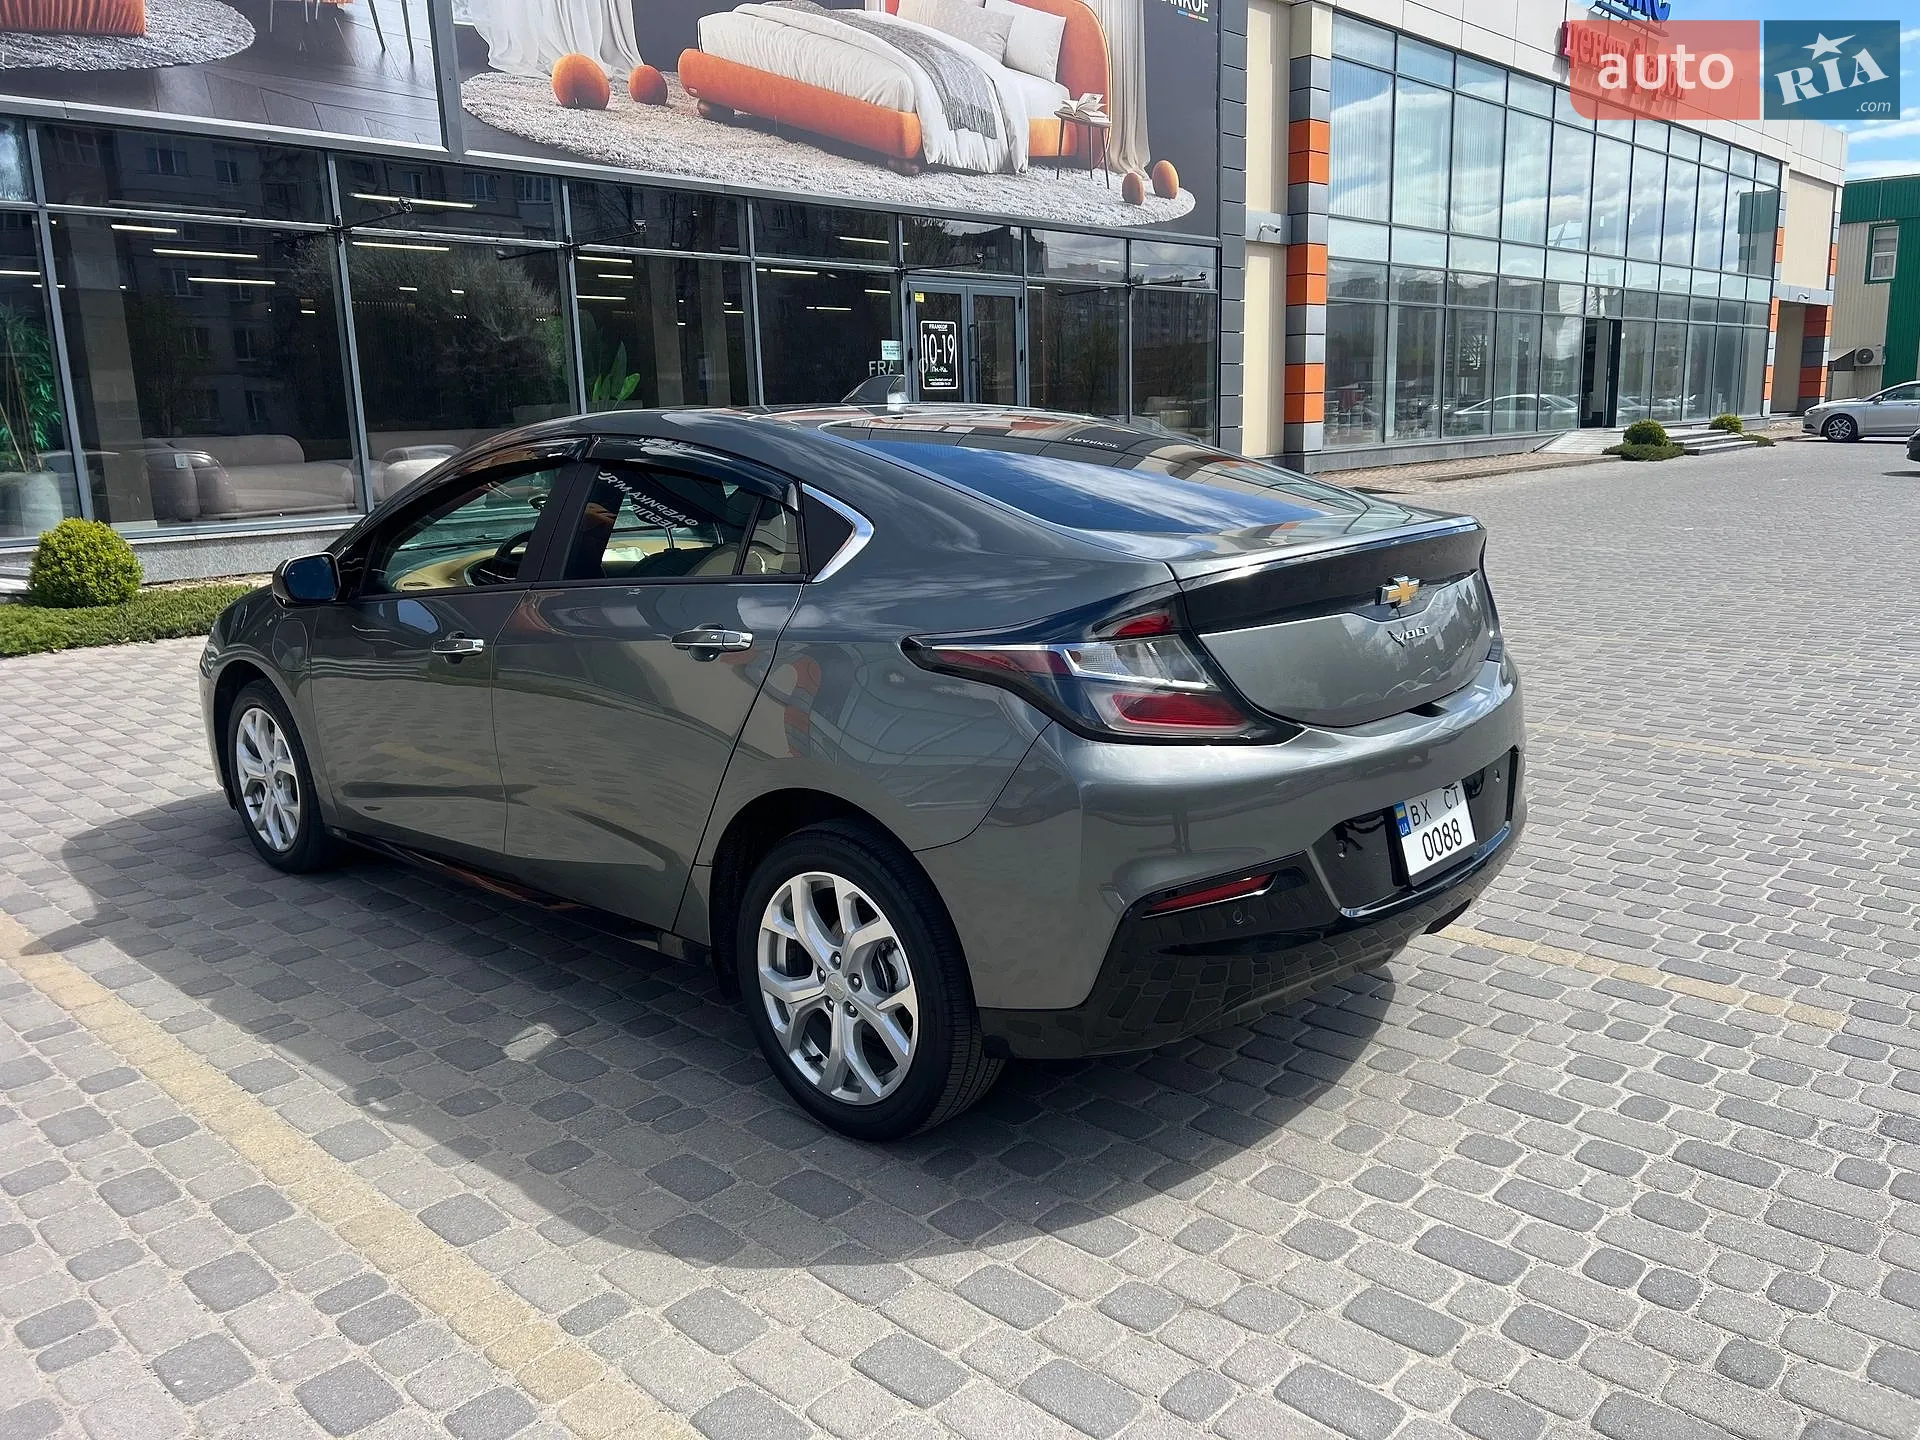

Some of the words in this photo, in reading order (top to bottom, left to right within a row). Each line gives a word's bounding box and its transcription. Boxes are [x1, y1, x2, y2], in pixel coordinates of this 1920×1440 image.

[923, 333, 955, 364] 10-19
[1388, 625, 1430, 647] VOLT
[1410, 799, 1432, 826] BX
[1443, 785, 1459, 809] CT
[1422, 818, 1462, 861] 0088
